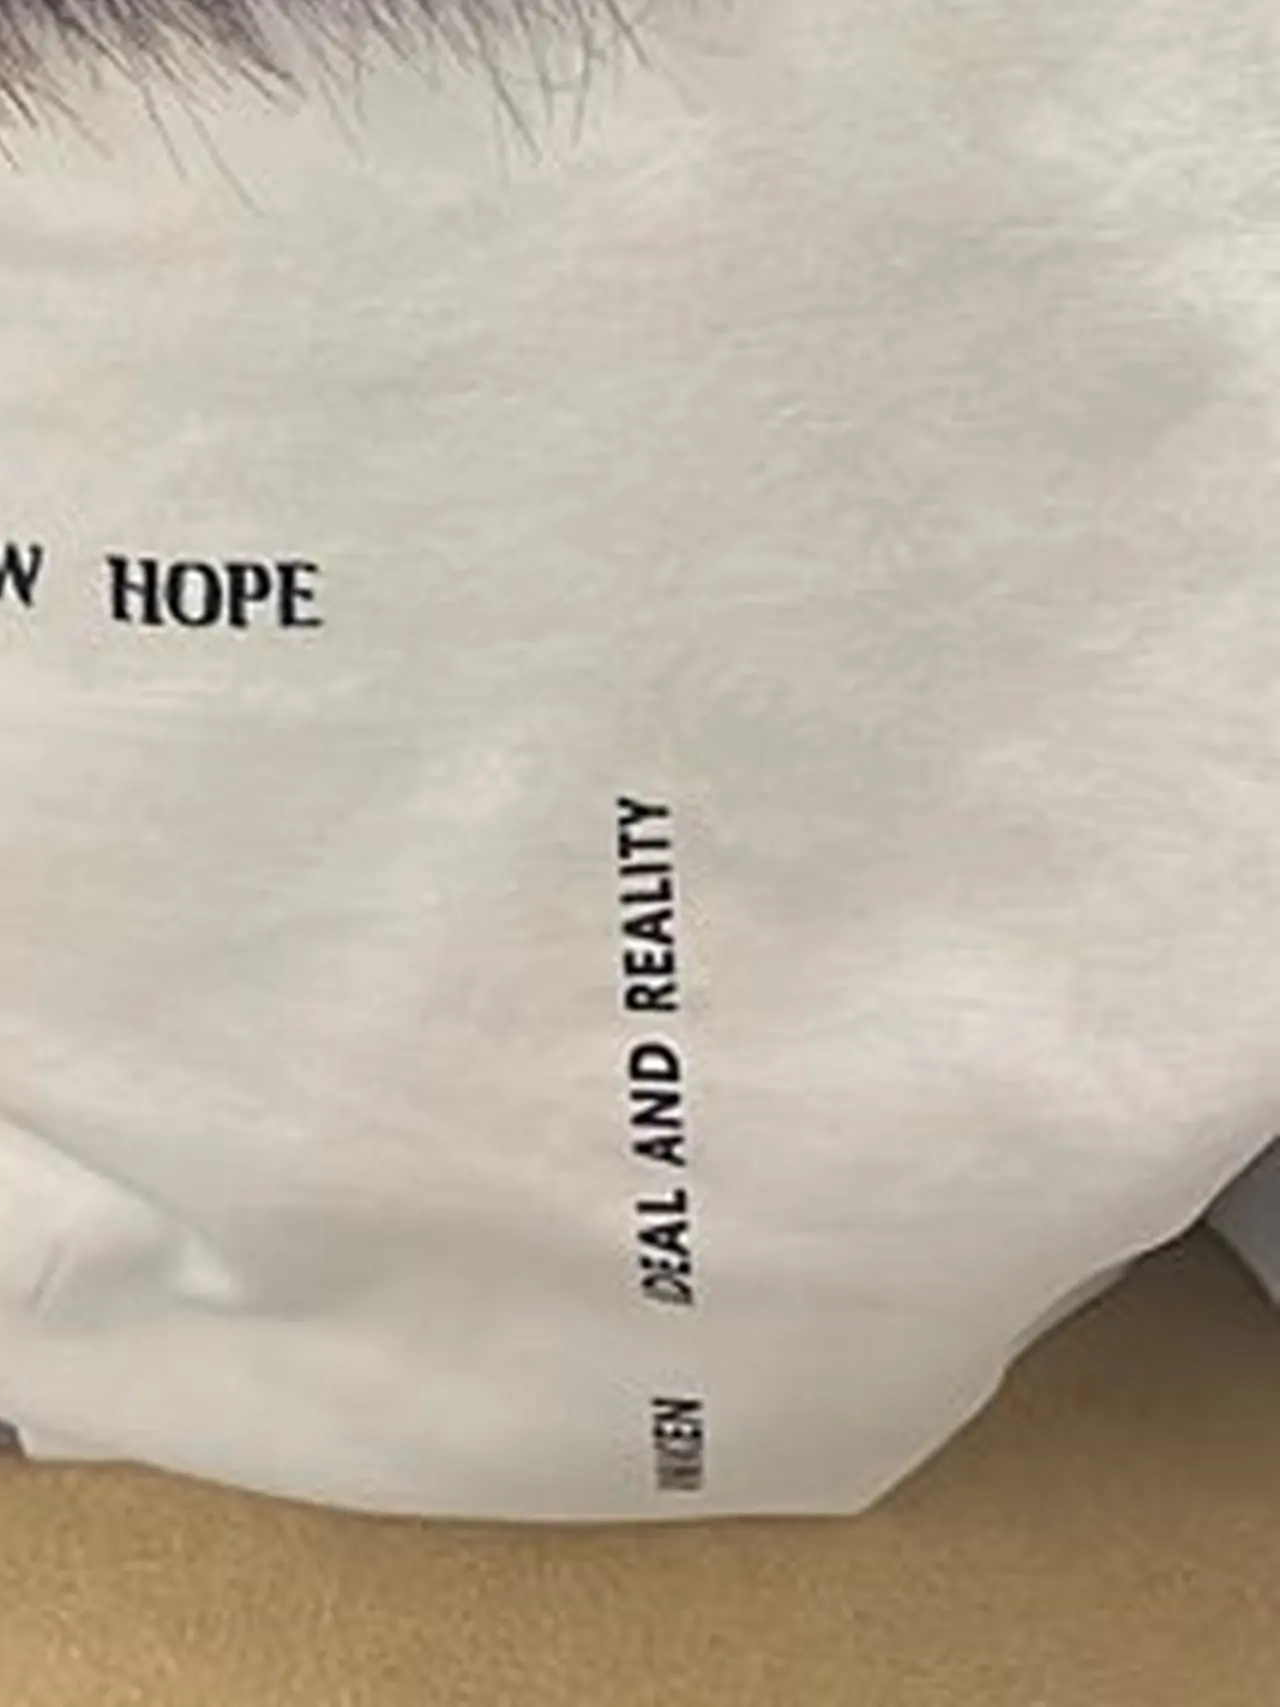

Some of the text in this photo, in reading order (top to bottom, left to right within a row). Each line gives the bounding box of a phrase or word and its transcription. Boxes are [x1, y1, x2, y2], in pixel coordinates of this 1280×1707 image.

[106, 554, 323, 630] HOPE
[615, 795, 679, 1014] REALITY
[627, 1042, 687, 1168] AND
